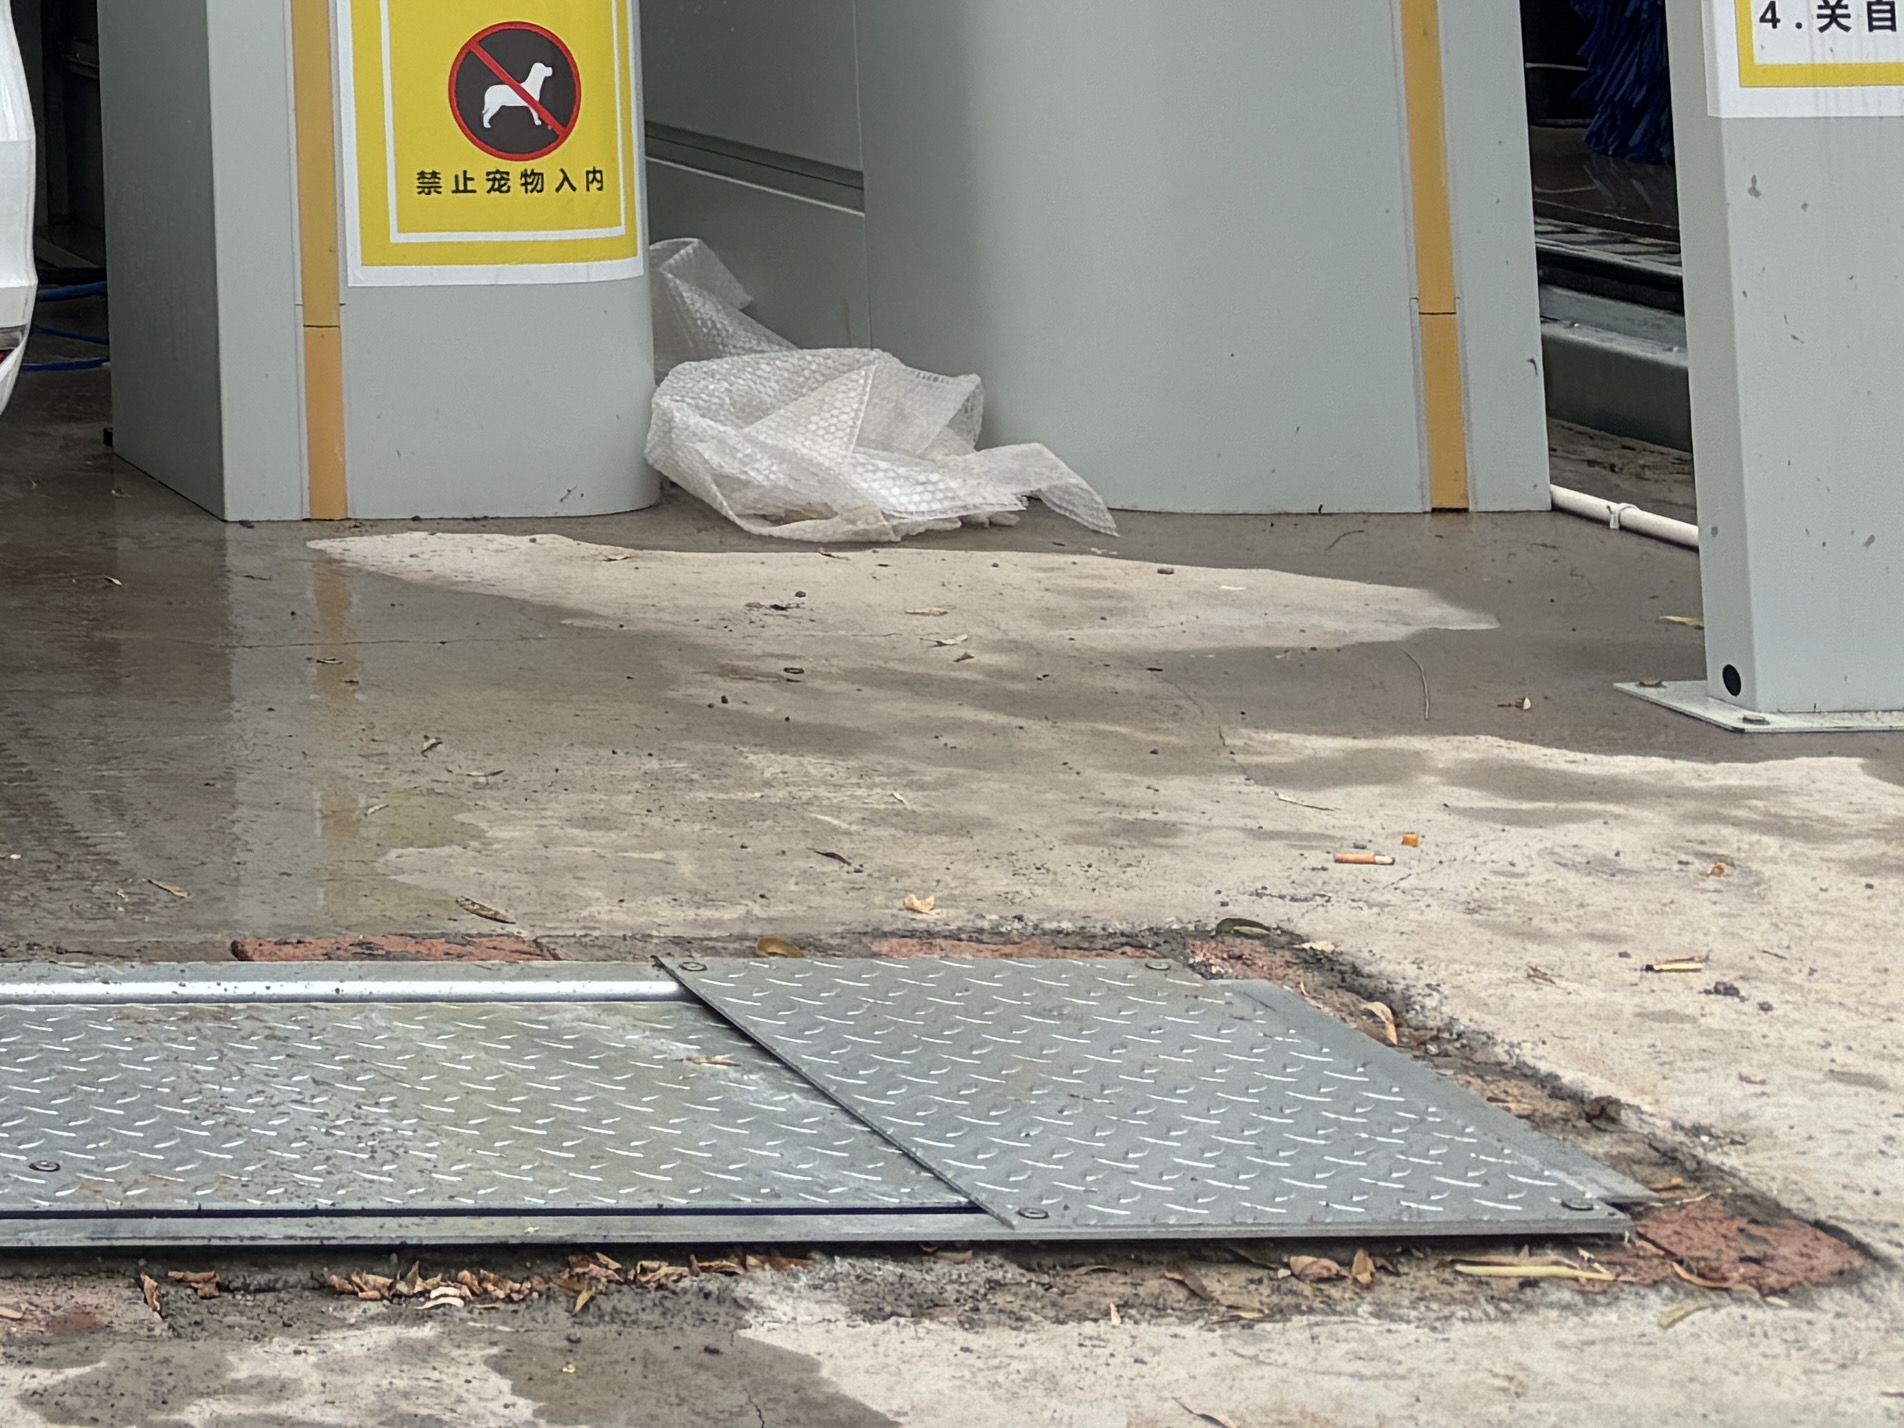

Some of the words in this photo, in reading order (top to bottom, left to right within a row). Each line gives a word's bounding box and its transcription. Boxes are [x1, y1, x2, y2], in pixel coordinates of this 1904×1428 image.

[416, 166, 604, 196] 禁止宠物入内
